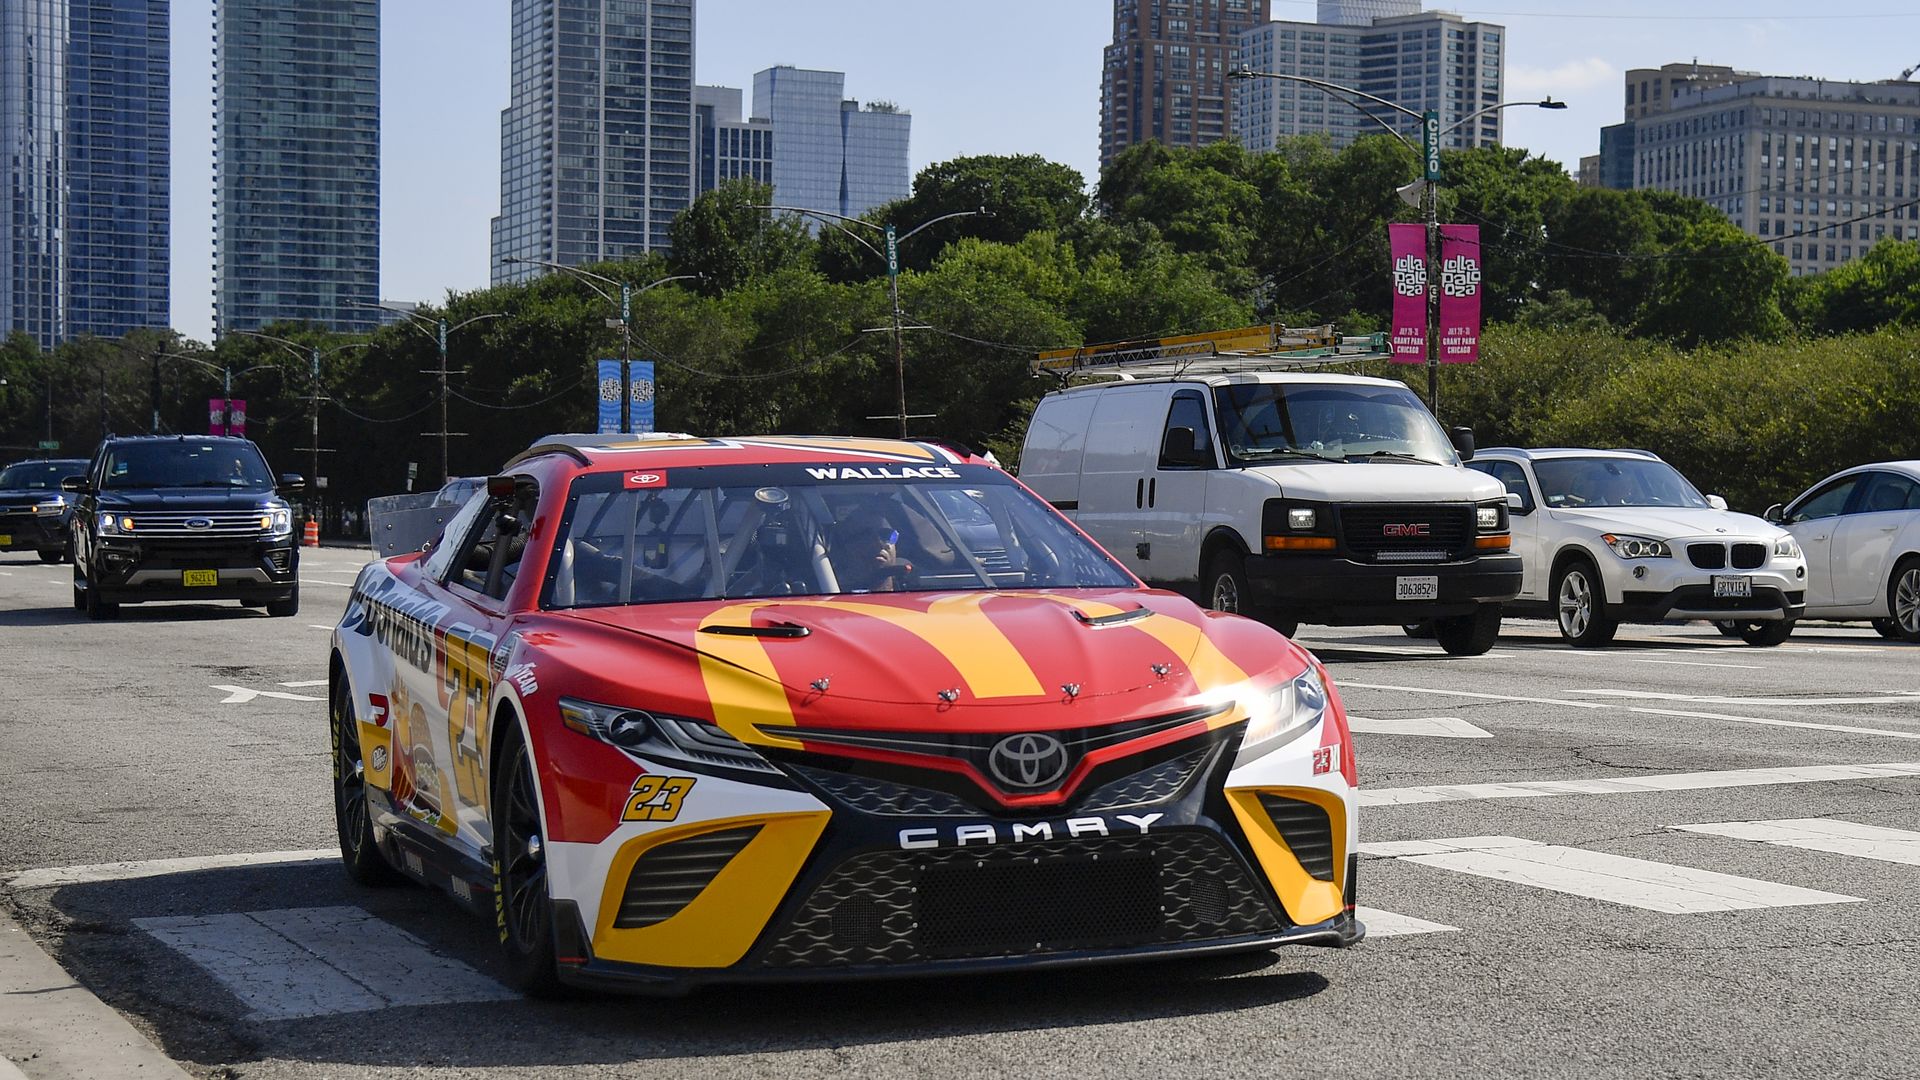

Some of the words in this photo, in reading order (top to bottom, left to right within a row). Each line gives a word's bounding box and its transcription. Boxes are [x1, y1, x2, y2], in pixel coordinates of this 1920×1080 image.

[1427, 119, 1439, 173] C520
[886, 231, 897, 270] C530
[1393, 336, 1410, 345] GRANT
[1410, 337, 1424, 346] PARK
[1442, 337, 1461, 346] GRANT
[1461, 337, 1476, 346] PARK
[1396, 345, 1419, 354] CHICAGO
[1447, 346, 1471, 354] CHICAGO
[805, 467, 961, 480] WALLACE
[1383, 523, 1430, 536] GMC
[621, 774, 698, 823] 23
[899, 812, 1164, 849] CAMRY
